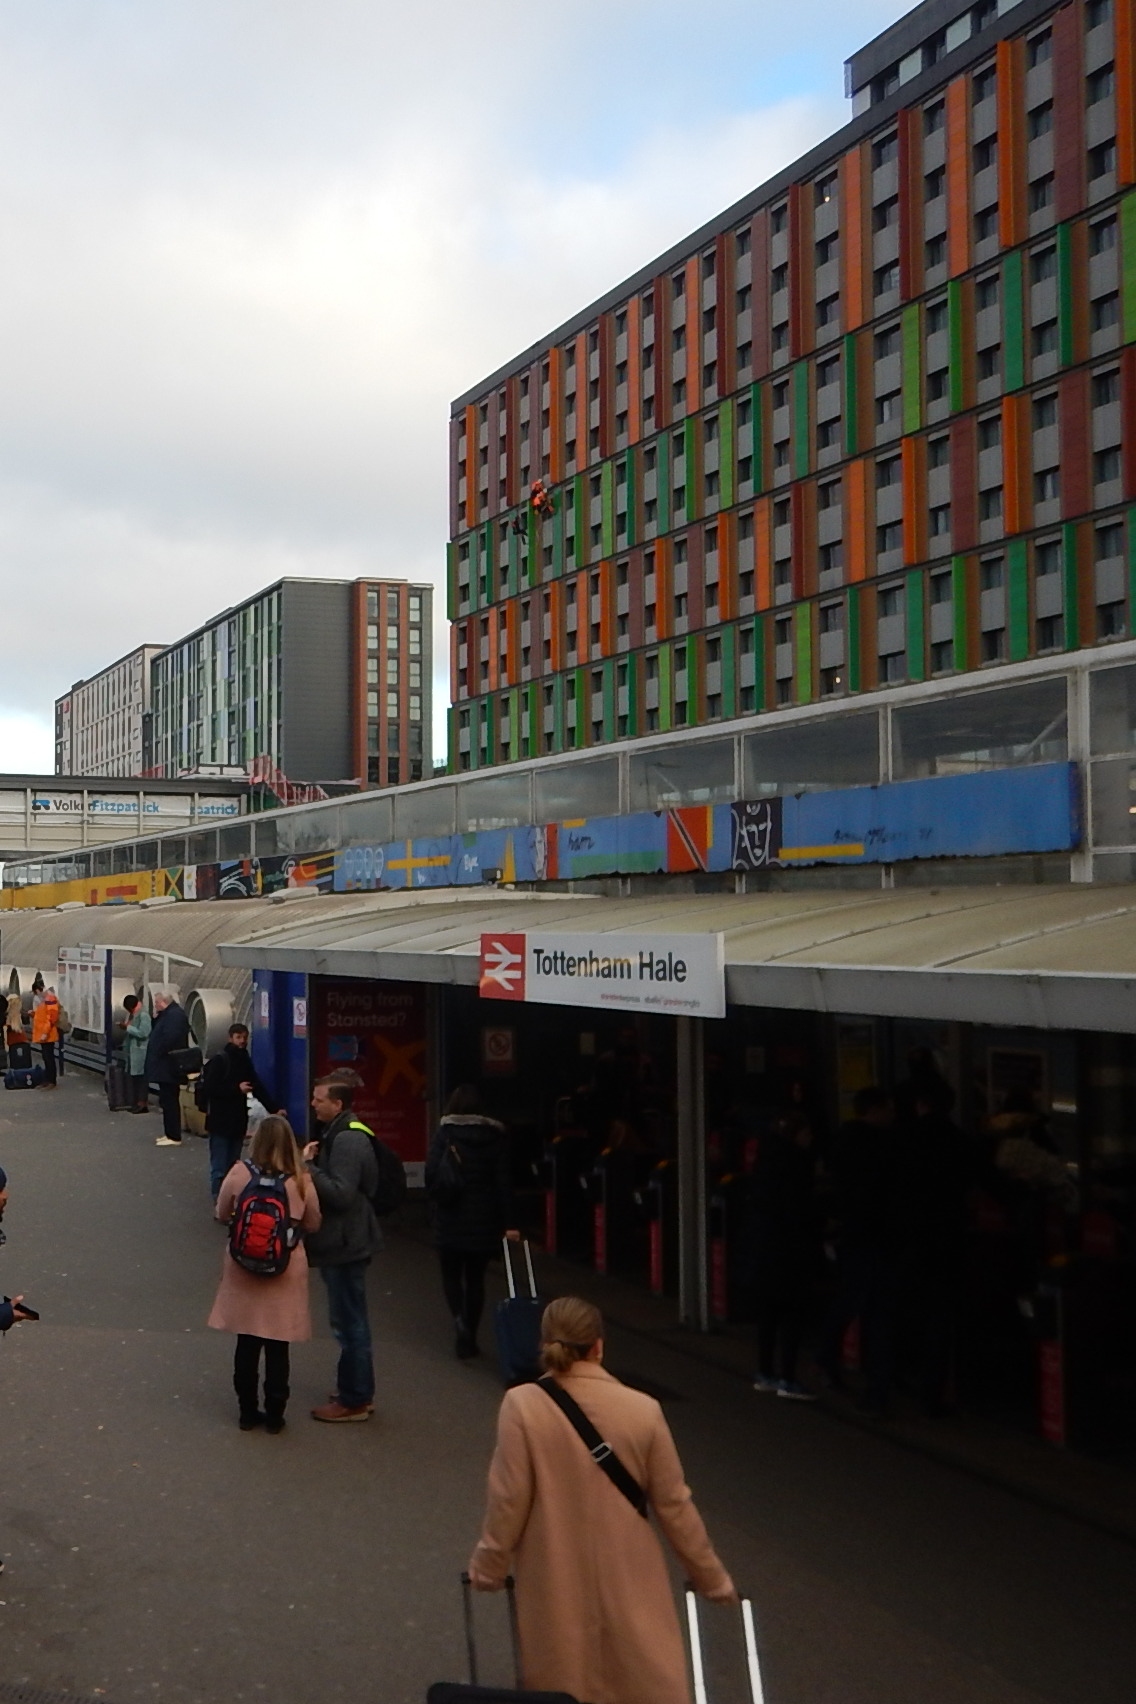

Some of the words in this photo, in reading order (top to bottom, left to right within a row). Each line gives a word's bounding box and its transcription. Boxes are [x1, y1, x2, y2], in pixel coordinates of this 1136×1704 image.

[533, 948, 632, 980] Tottenham
[638, 950, 687, 983] Hale
[327, 991, 373, 1011] Flying
[377, 991, 414, 1006] from
[327, 1011, 407, 1028] Stansted?
